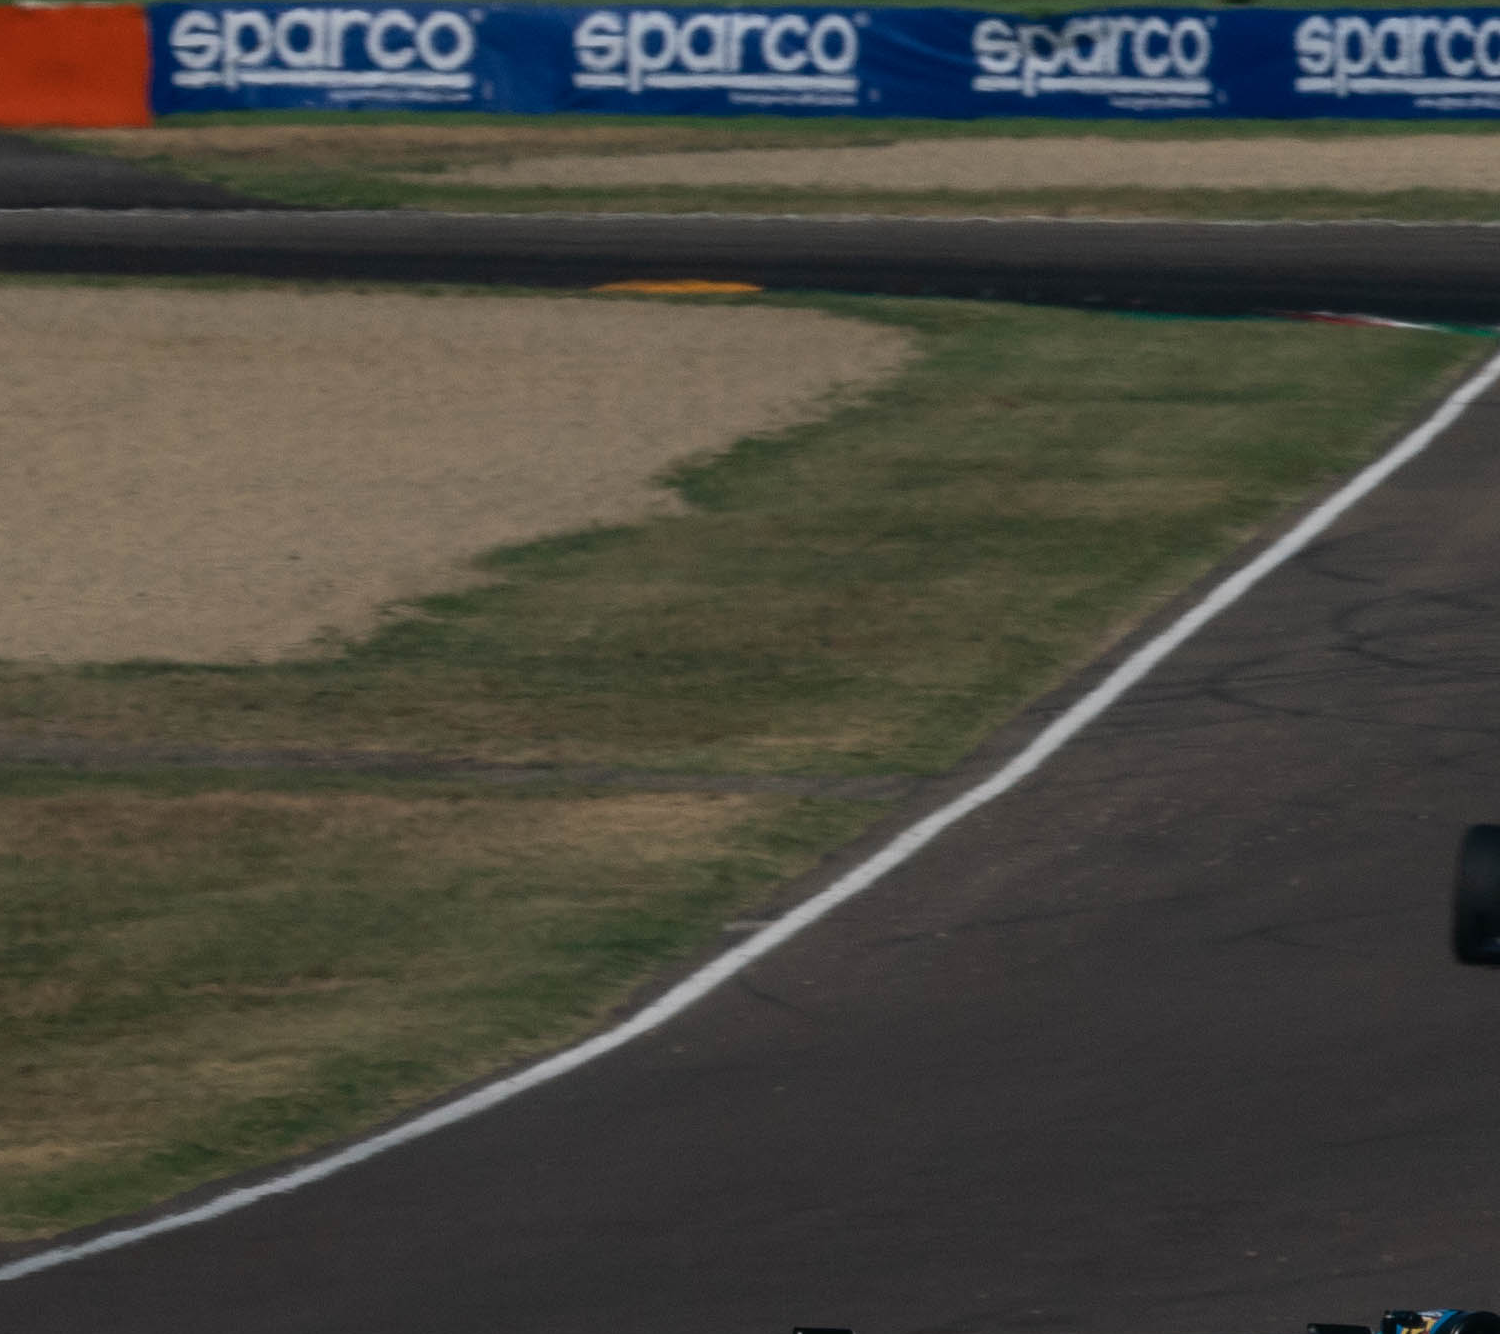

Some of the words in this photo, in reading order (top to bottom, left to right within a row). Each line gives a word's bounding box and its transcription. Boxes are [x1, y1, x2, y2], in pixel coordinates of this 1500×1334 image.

[169, 9, 477, 91] sparco
[572, 10, 858, 93] sparco
[971, 16, 1211, 96] sparco
